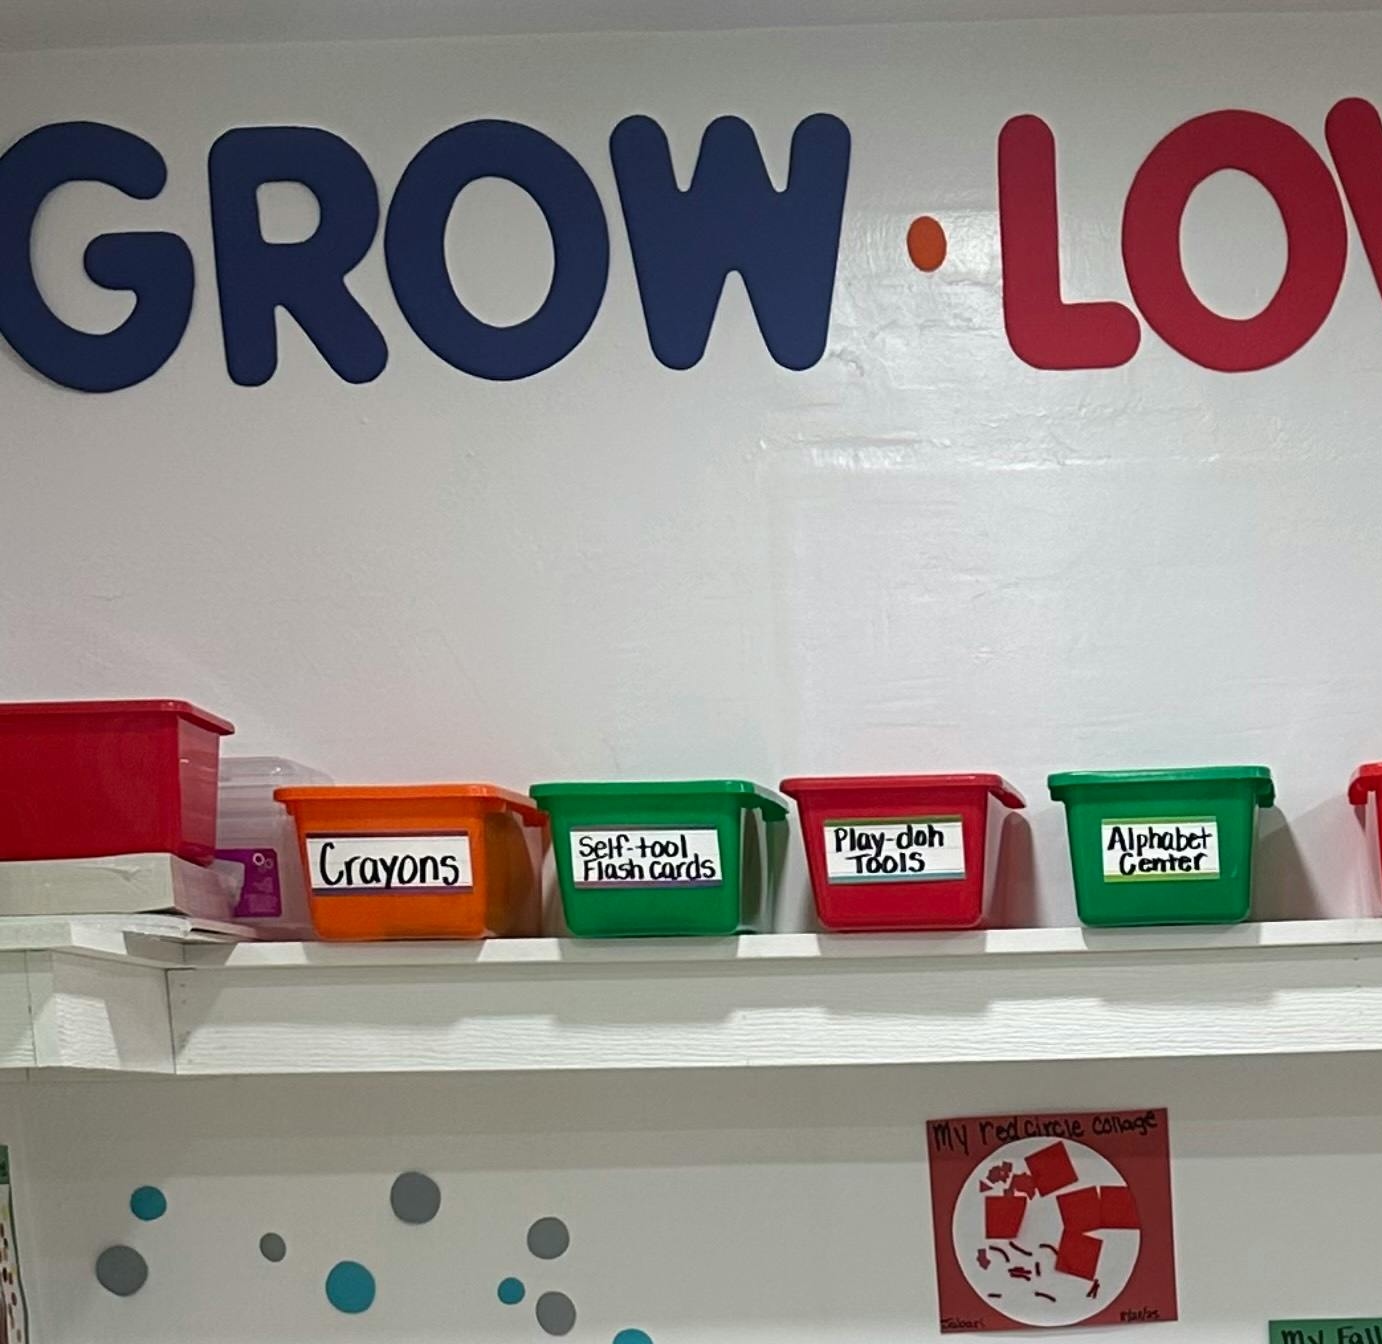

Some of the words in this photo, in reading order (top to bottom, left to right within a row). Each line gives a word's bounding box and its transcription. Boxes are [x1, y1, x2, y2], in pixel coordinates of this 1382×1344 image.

[0, 113, 852, 393] GROW
[578, 834, 690, 859] Self-tool
[833, 823, 945, 857] Play-doh
[1107, 825, 1214, 856] Alphabet
[319, 841, 460, 889] Crayons
[583, 857, 644, 882] Flash
[846, 851, 926, 875] Tools
[1119, 851, 1209, 876] Center
